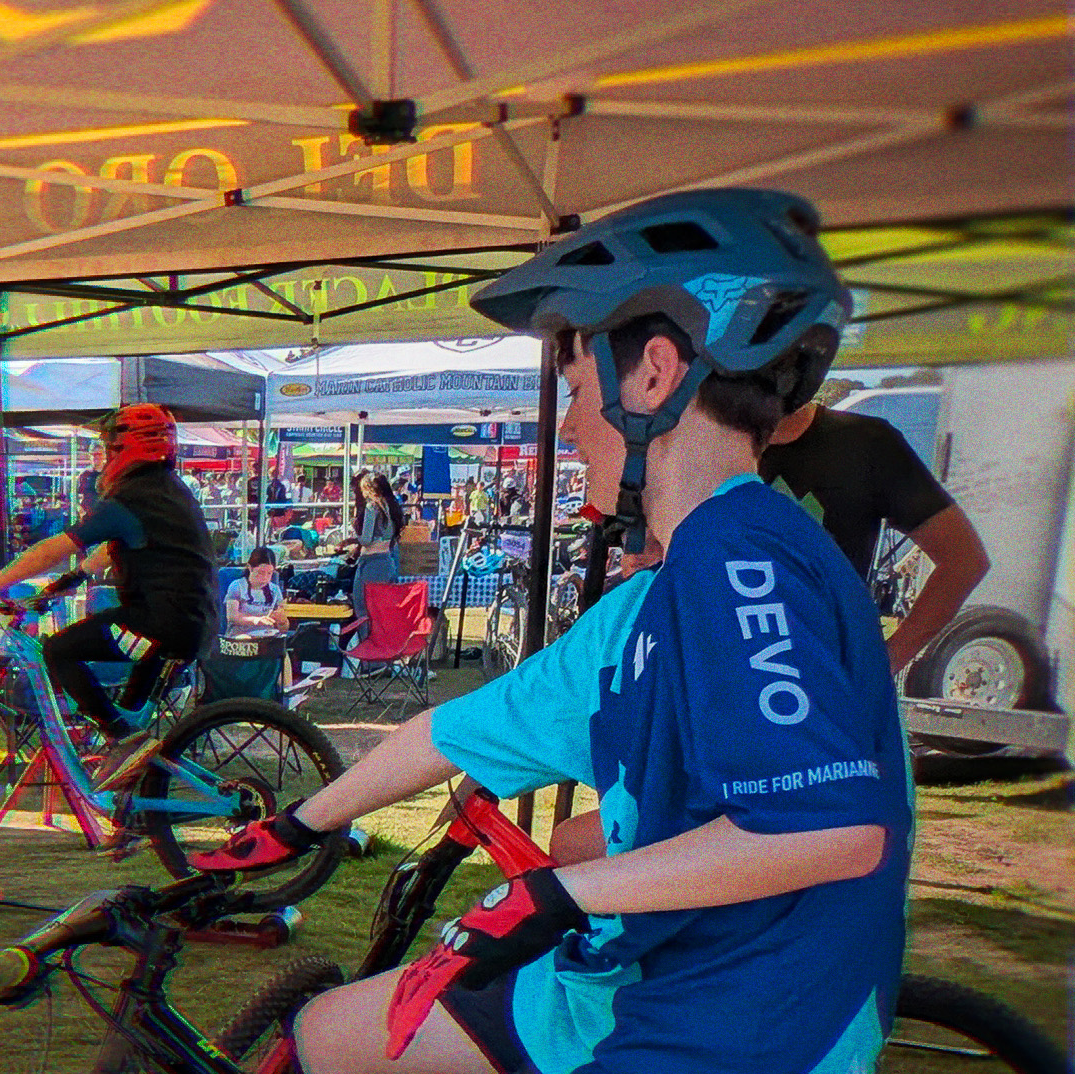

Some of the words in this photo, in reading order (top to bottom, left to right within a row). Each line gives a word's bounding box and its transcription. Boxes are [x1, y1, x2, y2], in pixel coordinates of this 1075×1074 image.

[438, 372, 519, 391] MOUNTAIN
[726, 561, 810, 725] DEVO
[722, 783, 728, 799] I
[732, 779, 769, 795] RIDE
[772, 771, 804, 793] FOR
